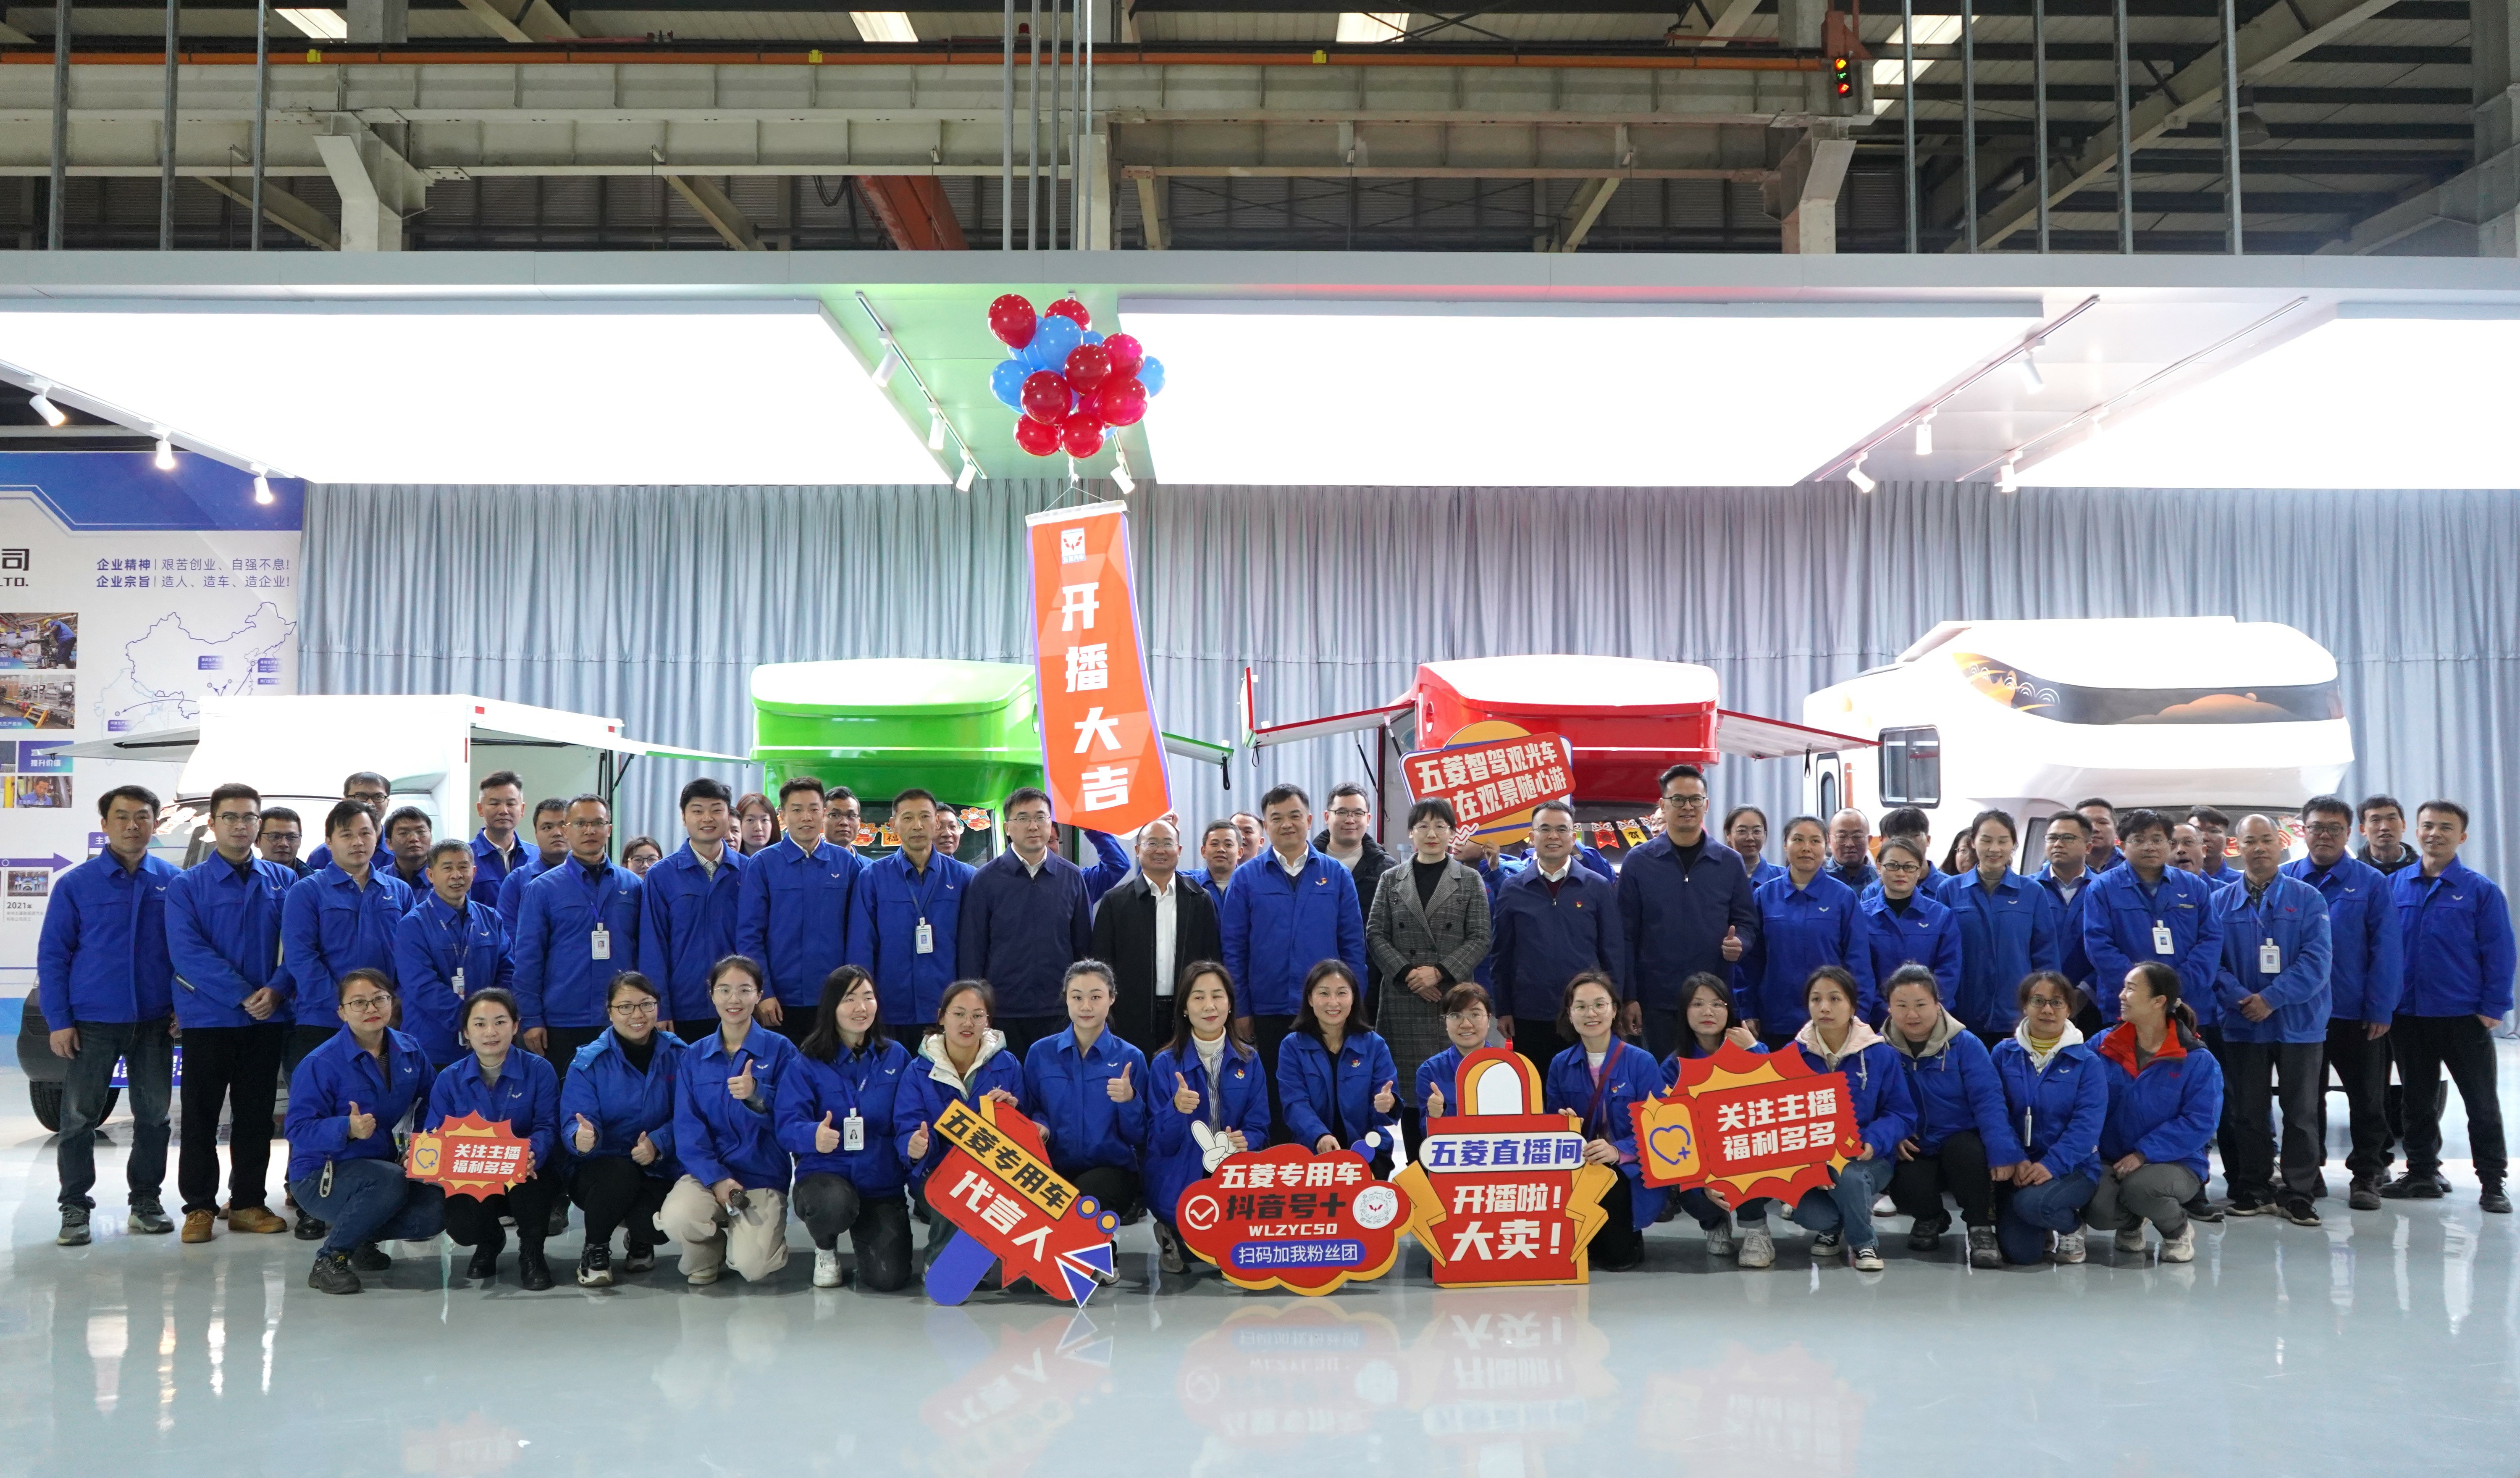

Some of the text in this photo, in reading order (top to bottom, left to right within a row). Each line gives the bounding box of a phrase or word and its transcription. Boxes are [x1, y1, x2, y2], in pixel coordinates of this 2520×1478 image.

[2, 549, 29, 571] 司
[97, 558, 289, 571] 企业精神 艰苦创业、自强不息！
[0, 577, 29, 586] TD.
[96, 576, 150, 588] 企业宗旨
[1061, 582, 1129, 812] 开播大吉
[1415, 741, 1557, 794] 五菱智驾观光车
[1445, 765, 1567, 822] 在观景随心游
[1717, 1087, 1837, 1132] 关注主播
[454, 1144, 521, 1160] 关注主播
[1428, 1138, 1583, 1167] 五菱直播间
[1722, 1120, 1836, 1162] 福利多多
[452, 1160, 515, 1175] 福利多多
[940, 1108, 1072, 1211] 五菱专用车
[1219, 1162, 1363, 1189] 五菱专用车
[1453, 1183, 1562, 1215] 开播啦！
[949, 1170, 1053, 1262] 代言人
[1238, 1244, 1358, 1265] 扫码加我粉丝团
[1449, 1219, 1562, 1261] 大卖！
